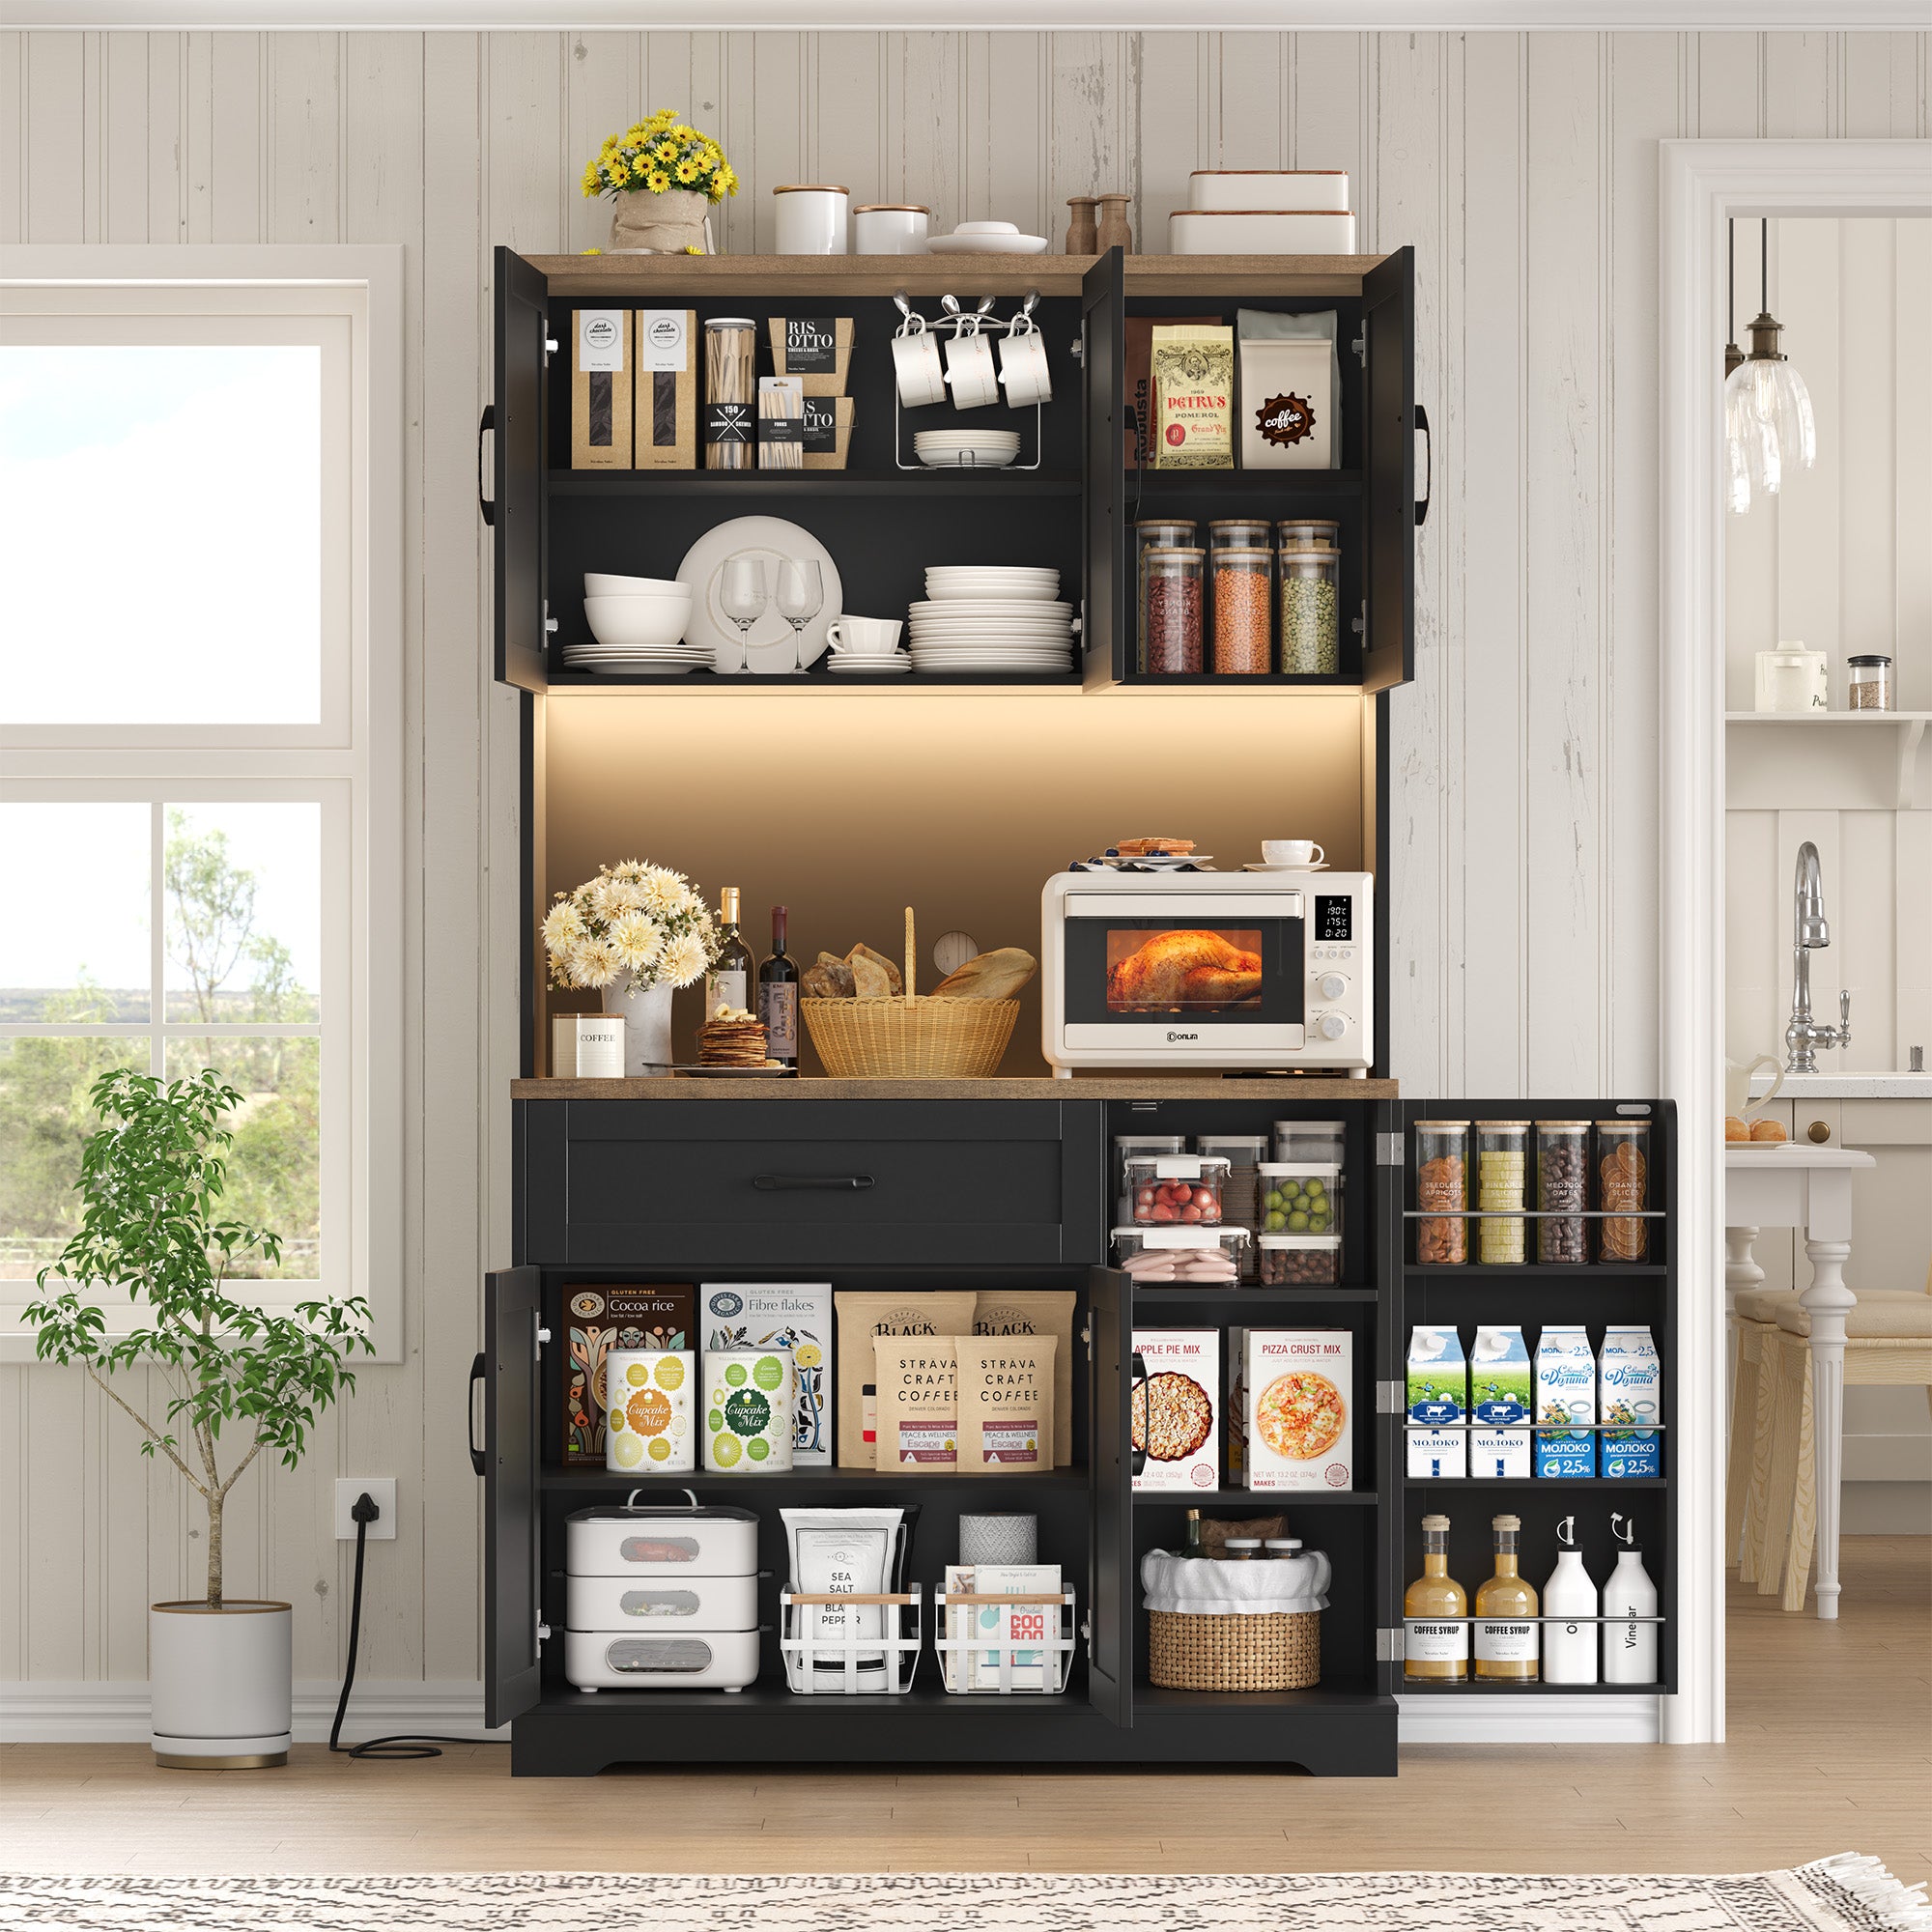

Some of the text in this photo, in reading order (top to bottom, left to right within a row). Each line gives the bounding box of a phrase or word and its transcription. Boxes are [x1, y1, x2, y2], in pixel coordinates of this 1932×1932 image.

[788, 322, 815, 334] RIS
[788, 334, 833, 348] OTTO
[803, 413, 834, 427] TTO
[1265, 410, 1302, 429] coffee
[611, 1300, 674, 1311] Cocoa rice
[749, 1299, 814, 1311] Fibre flakes
[1135, 1346, 1201, 1354] APPLE PIE MIX
[1263, 1345, 1341, 1354] PIZZA CRUST MIX
[903, 1375, 954, 1385] CRAFT
[985, 1375, 1034, 1384] CRAFT
[1541, 1368, 1588, 1387] Долина
[1605, 1368, 1653, 1387] Долина
[898, 1391, 957, 1402] COFFEE
[980, 1391, 1038, 1402] COFFEE
[629, 1403, 668, 1418] Cupcake
[727, 1403, 768, 1418] Cupcake
[639, 1415, 665, 1427] Mix
[738, 1415, 763, 1427] Mix
[908, 1439, 941, 1449] Escape
[991, 1439, 1023, 1449] Escape
[1542, 1444, 1591, 1453] МОЛОКО
[1605, 1444, 1656, 1453] МОЛОКО
[1563, 1460, 1591, 1475] 2,5%
[1628, 1460, 1656, 1475] 2,5%
[832, 1573, 852, 1581] SEA
[830, 1585, 854, 1594] SALT
[1010, 1615, 1055, 1630] COO
[1625, 1605, 1636, 1649] Vinear
[1414, 1626, 1460, 1634] COFFEE SYRUP
[1485, 1626, 1530, 1634] COFFEE SYRUP
